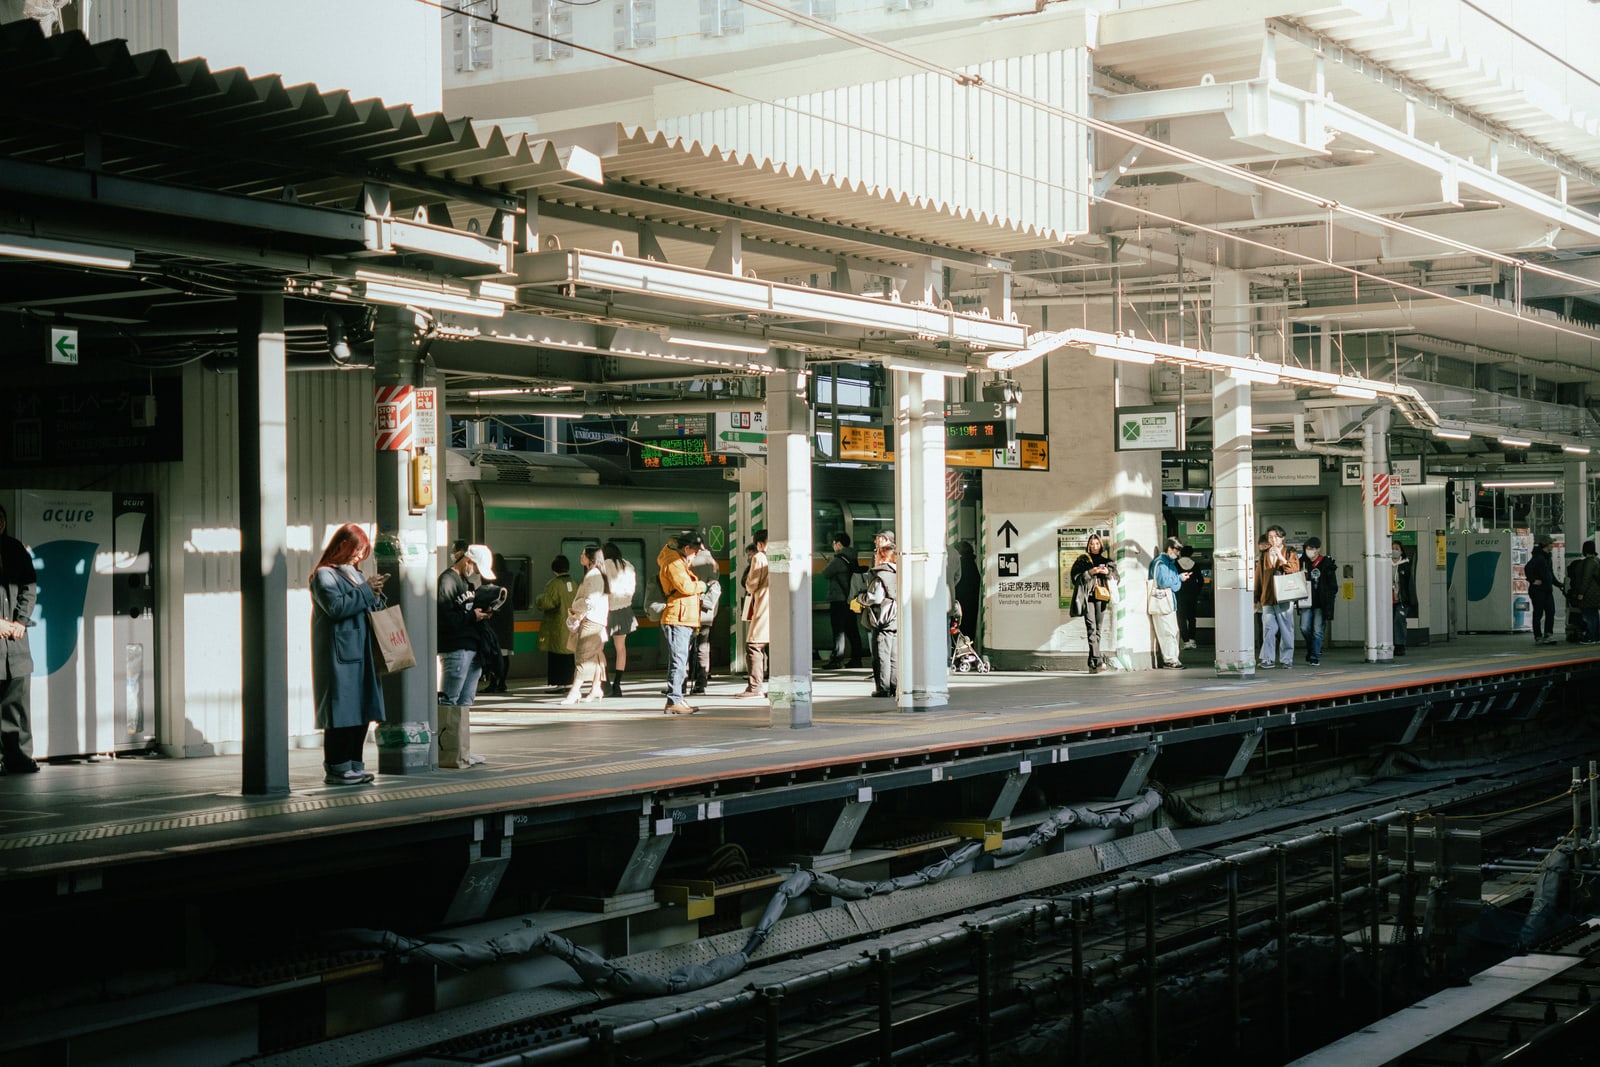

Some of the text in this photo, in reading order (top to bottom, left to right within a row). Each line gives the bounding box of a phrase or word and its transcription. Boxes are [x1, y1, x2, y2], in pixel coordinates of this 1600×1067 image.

[378, 405, 396, 414] STOP
[993, 402, 1002, 418] 3
[630, 420, 640, 435] 4
[946, 426, 969, 437] 15:19
[122, 499, 145, 507] acure
[42, 508, 95, 523] acure
[998, 582, 1051, 593] 指定席券売機
[998, 592, 1022, 600] Reserved
[1023, 592, 1035, 600] Seat
